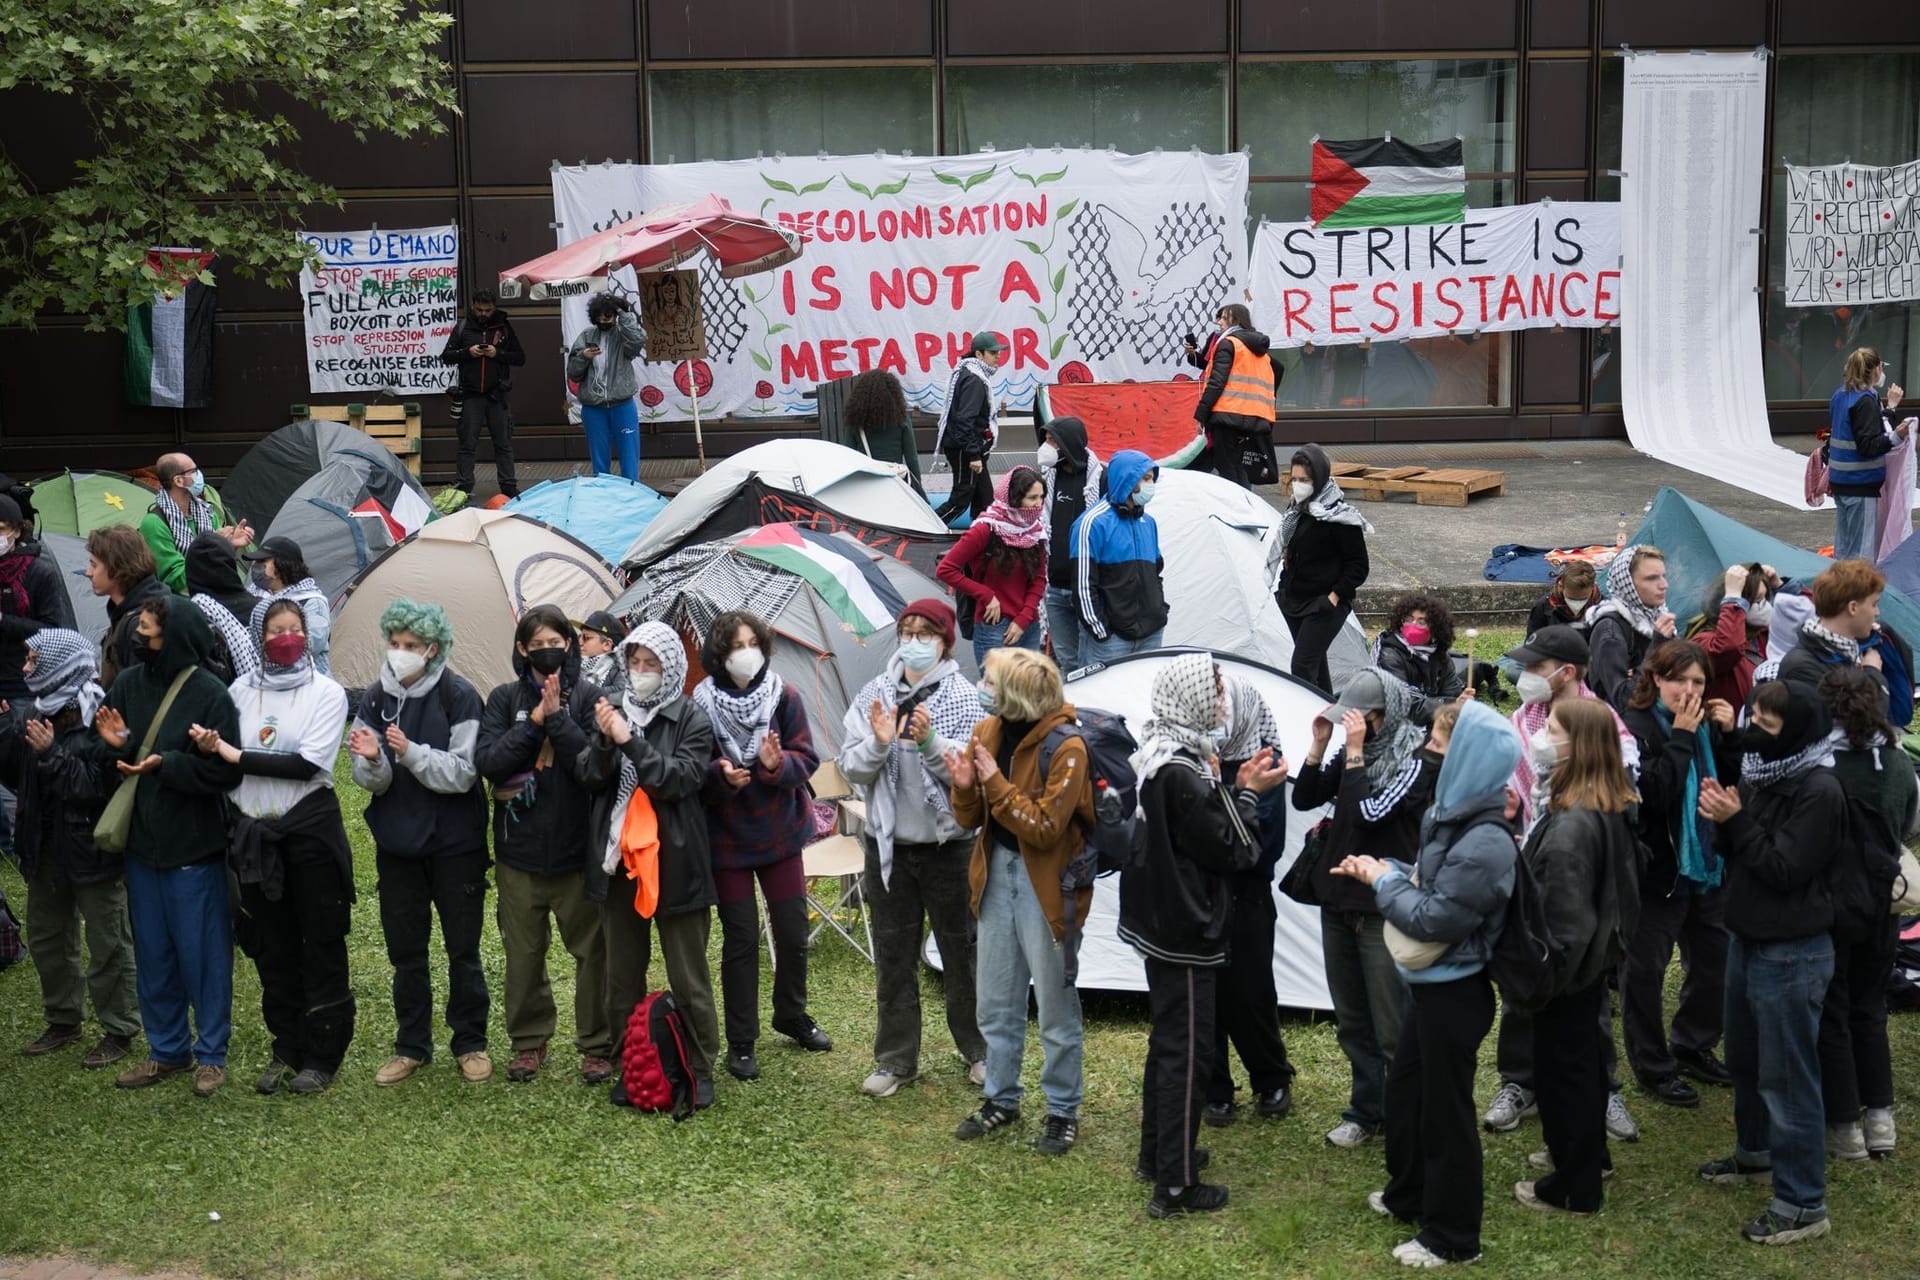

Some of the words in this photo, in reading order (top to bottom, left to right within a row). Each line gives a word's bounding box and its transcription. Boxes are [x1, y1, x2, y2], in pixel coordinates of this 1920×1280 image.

[1788, 170, 1845, 201] WENN
[1789, 202, 1814, 235] ZU
[1824, 200, 1884, 234] RECHT
[306, 236, 354, 256] OUR
[369, 234, 456, 259] DEMAND
[1280, 222, 1488, 279] STRIKE
[1533, 217, 1584, 266] IS
[1788, 236, 1835, 269] WIRD
[315, 268, 362, 289] STOP
[371, 268, 403, 283] THE
[408, 267, 457, 280] GENOCIDE
[362, 278, 452, 297] PALESTINE
[545, 280, 589, 297] Marlboro
[783, 265, 841, 315] IS
[870, 265, 980, 311] NOT
[1000, 260, 1041, 304] A
[1792, 270, 1833, 302] ZUR
[308, 291, 371, 317] FULL
[1283, 271, 1621, 338] RESISTANCE
[330, 314, 392, 331] BOYCOTT
[397, 313, 416, 328] OF
[313, 335, 345, 347] STOP
[354, 330, 425, 345] REPRESSION
[363, 343, 426, 356] STUDENTS
[315, 357, 407, 372] RECOGNISE
[411, 355, 452, 369] GERM
[345, 371, 407, 388] COLONIAL
[408, 370, 455, 388] LEGACY
